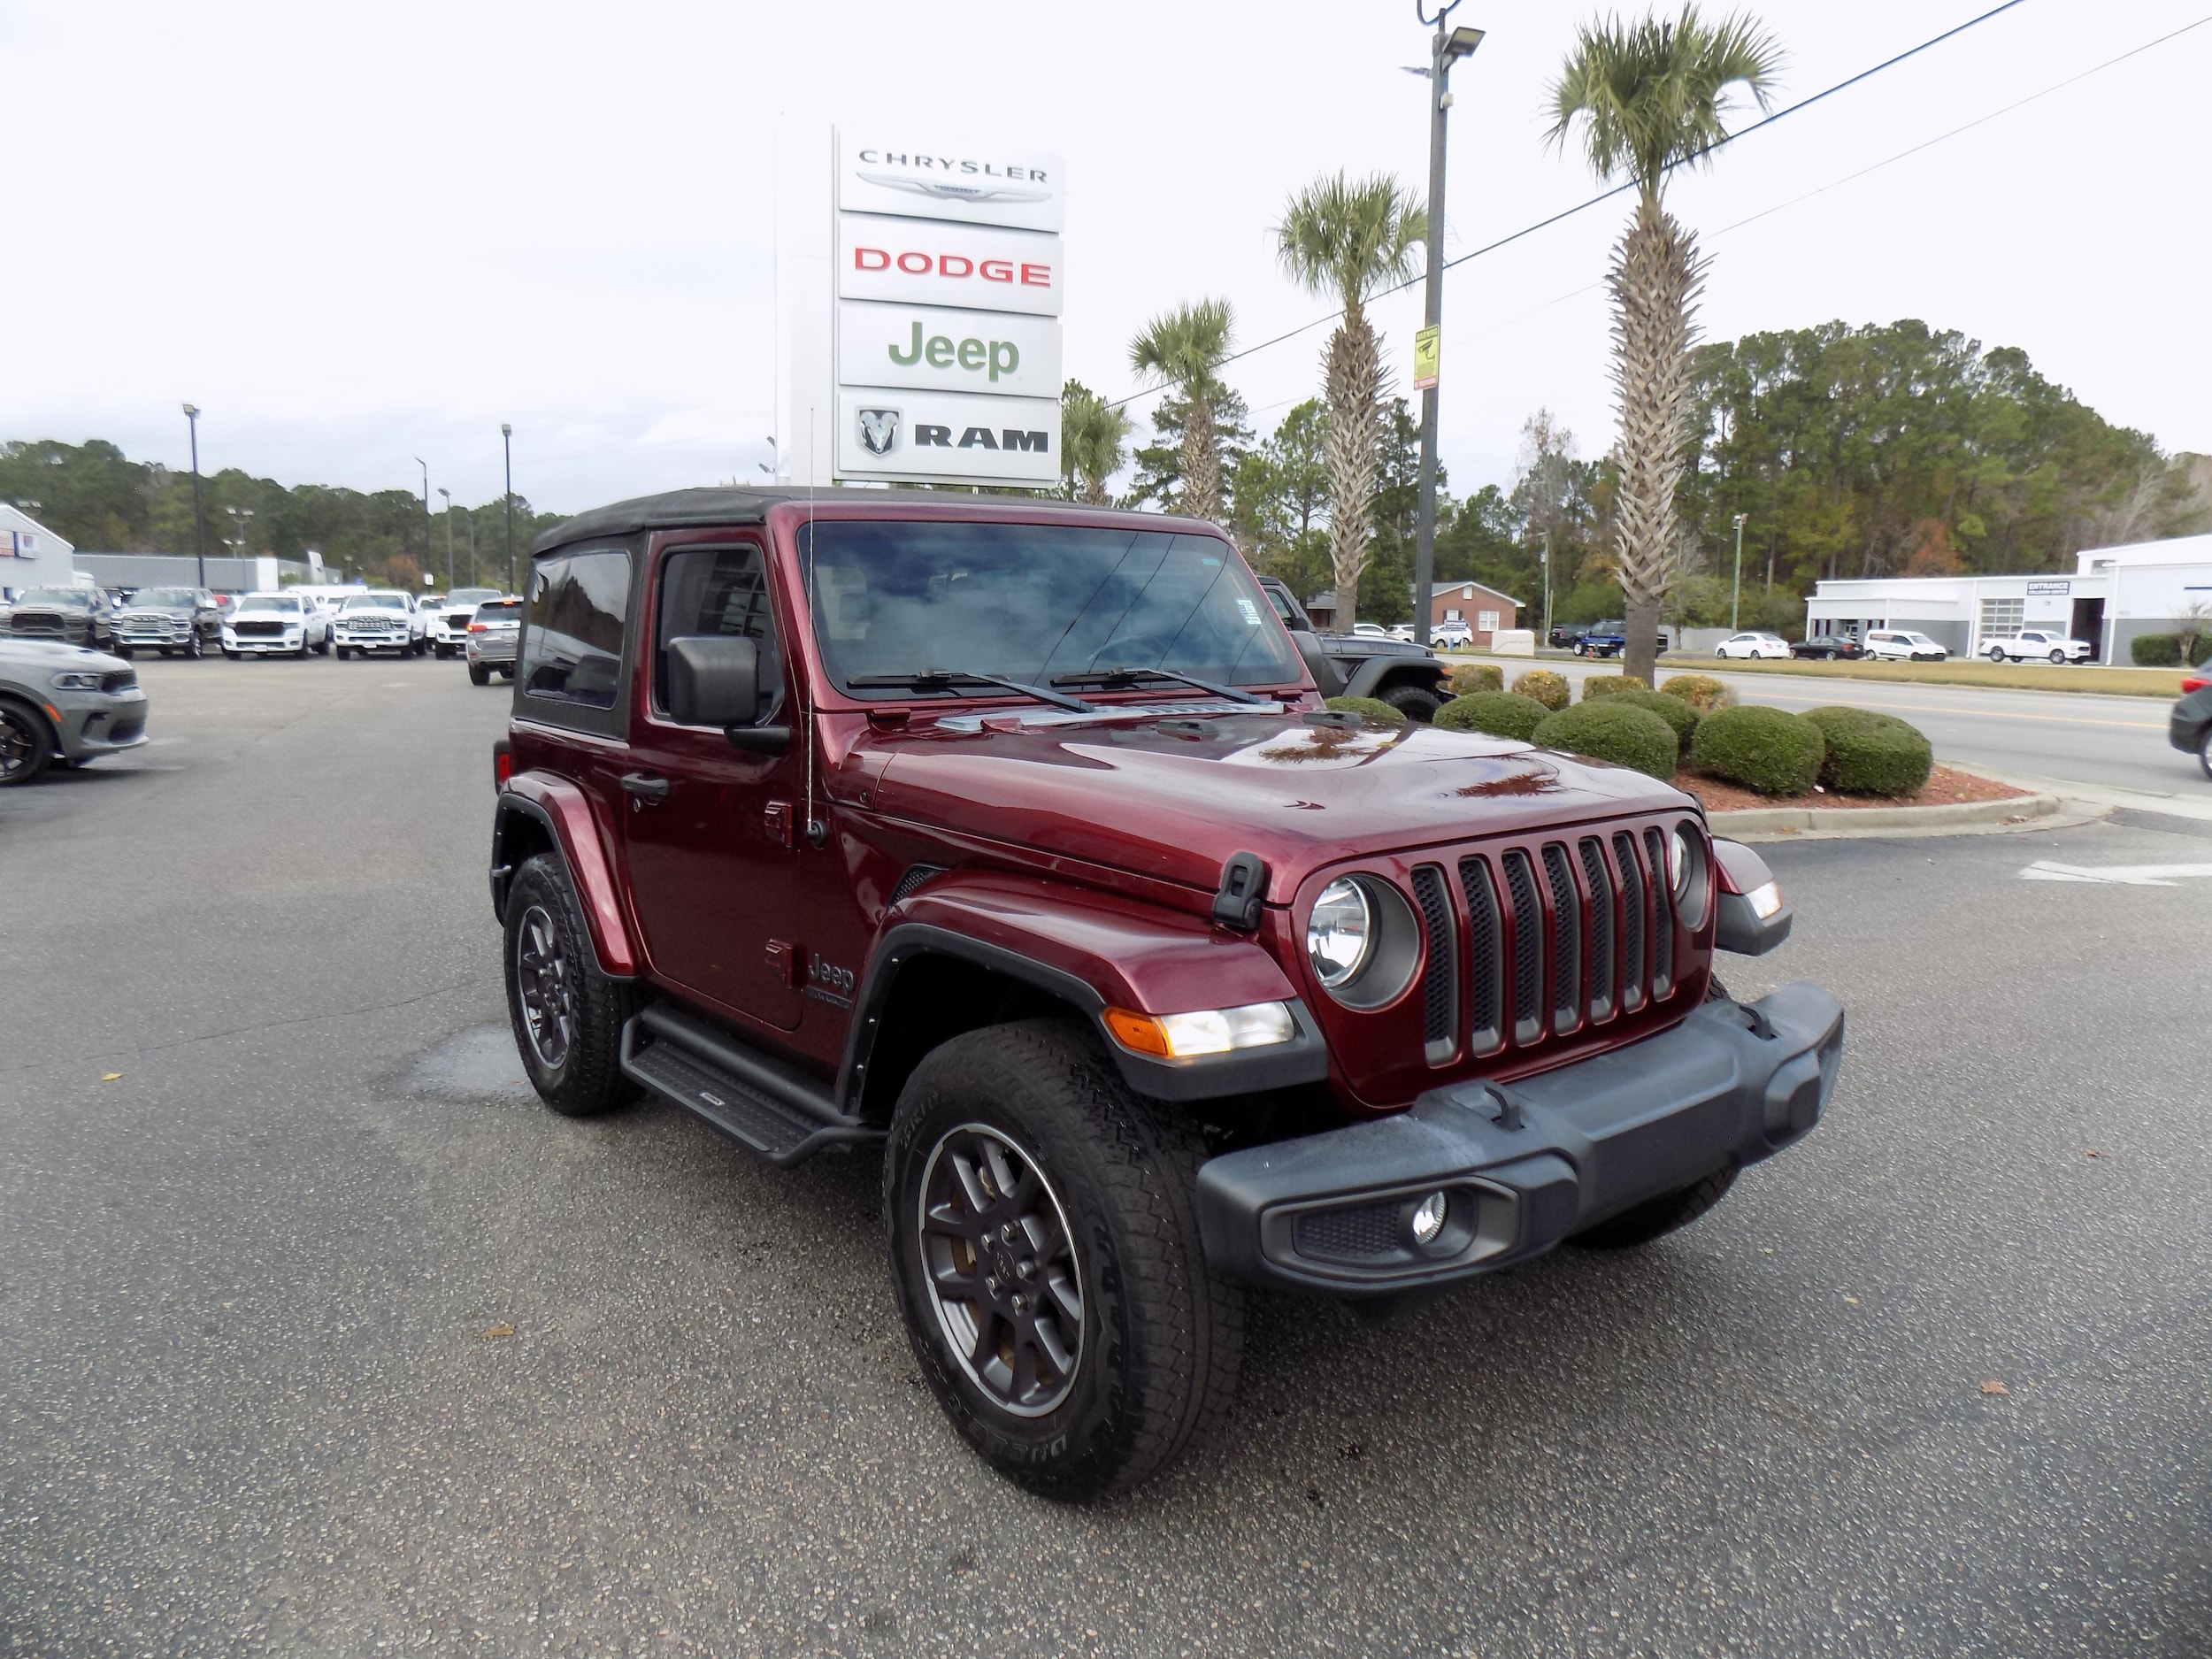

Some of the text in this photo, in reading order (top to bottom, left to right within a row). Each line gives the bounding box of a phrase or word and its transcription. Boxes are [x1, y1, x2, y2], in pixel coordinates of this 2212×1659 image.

[858, 149, 1048, 183] CHRYSLER
[855, 247, 1051, 288] DODGE
[888, 321, 1020, 382] Jeep
[915, 424, 1049, 454] RAM
[808, 953, 855, 996] Jeep
